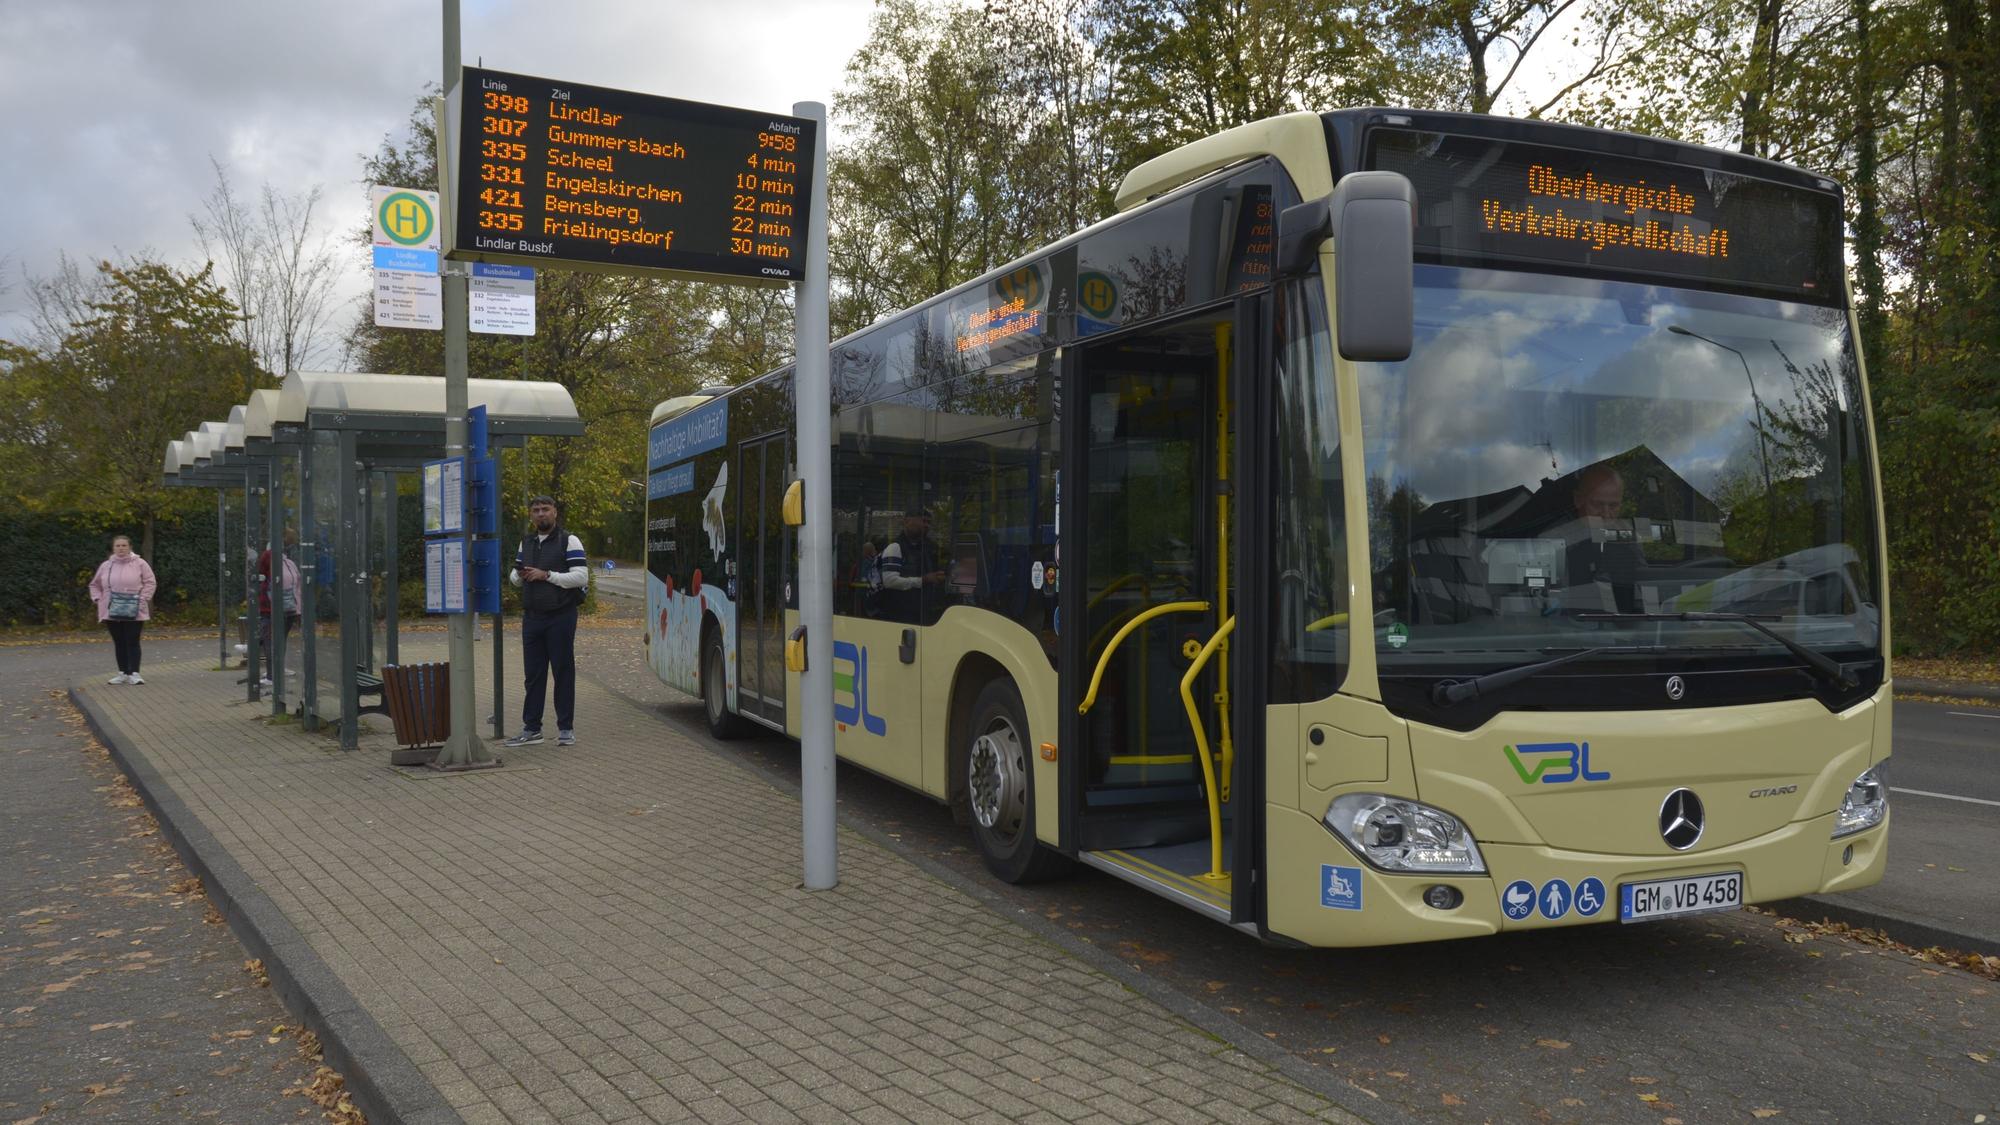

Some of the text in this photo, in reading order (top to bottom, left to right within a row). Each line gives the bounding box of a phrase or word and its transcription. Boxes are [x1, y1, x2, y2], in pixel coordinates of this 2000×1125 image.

[482, 78, 800, 135] Linie Ziel Abfahrt
[483, 92, 796, 152] 398 Lindlar 9:58
[482, 116, 796, 174] 307 Gummersbach 4 min
[482, 139, 794, 195] 335 Scheel 10 min
[480, 187, 791, 237] 421 Bensberg 22 min
[481, 163, 792, 216] 331 Engelskirchen 22 min
[1528, 164, 1695, 215] Oberbergische
[396, 203, 418, 234] H
[479, 211, 789, 258] 335 Frielingsdorf 30 min
[1483, 199, 1729, 257] Verkehrsgesellschaft
[476, 236, 556, 254] Lindlar Busbf.
[761, 267, 790, 276] OVAG
[833, 640, 886, 737] BL
[1503, 742, 1611, 784] VBL
[1749, 785, 1798, 799] CITARO
[1634, 886, 1661, 913] GM
[1674, 882, 1698, 908] VB
[1703, 878, 1737, 905] 458
